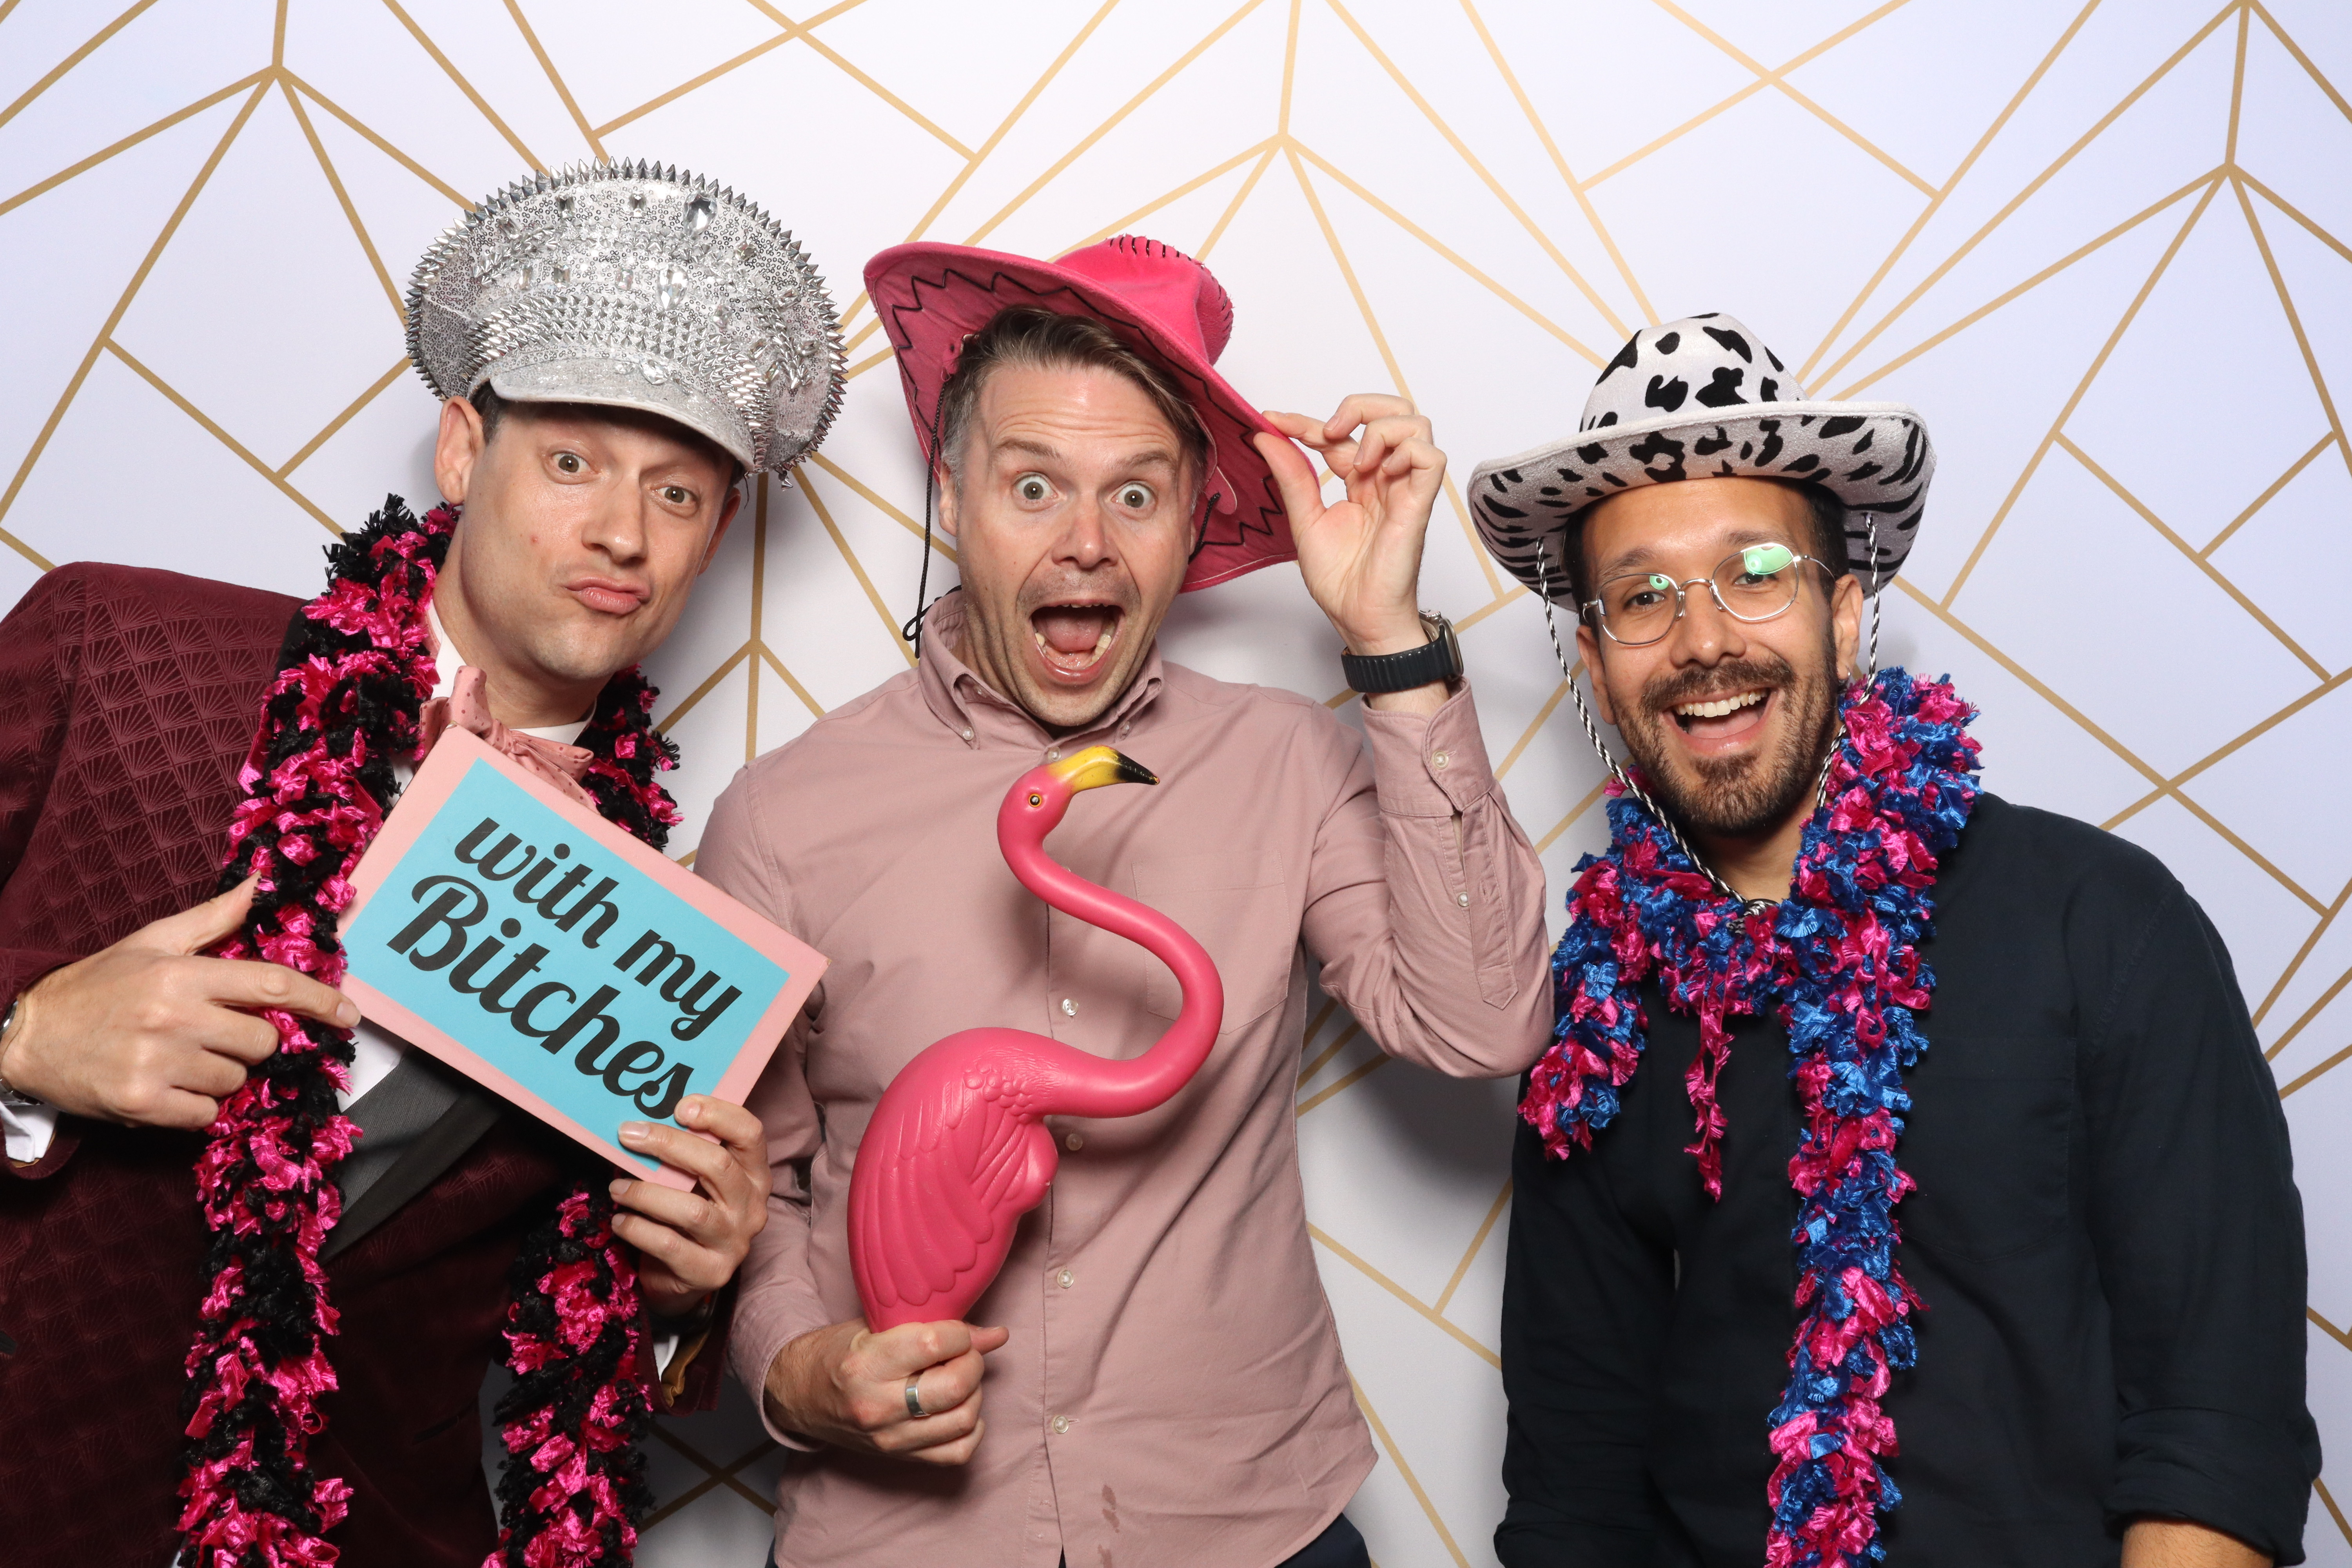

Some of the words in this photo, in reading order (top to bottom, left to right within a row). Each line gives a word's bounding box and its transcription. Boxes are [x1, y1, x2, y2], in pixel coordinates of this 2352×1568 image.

[387, 875, 694, 1120] Bitches
[455, 817, 619, 949] with
[613, 929, 742, 1041] my
